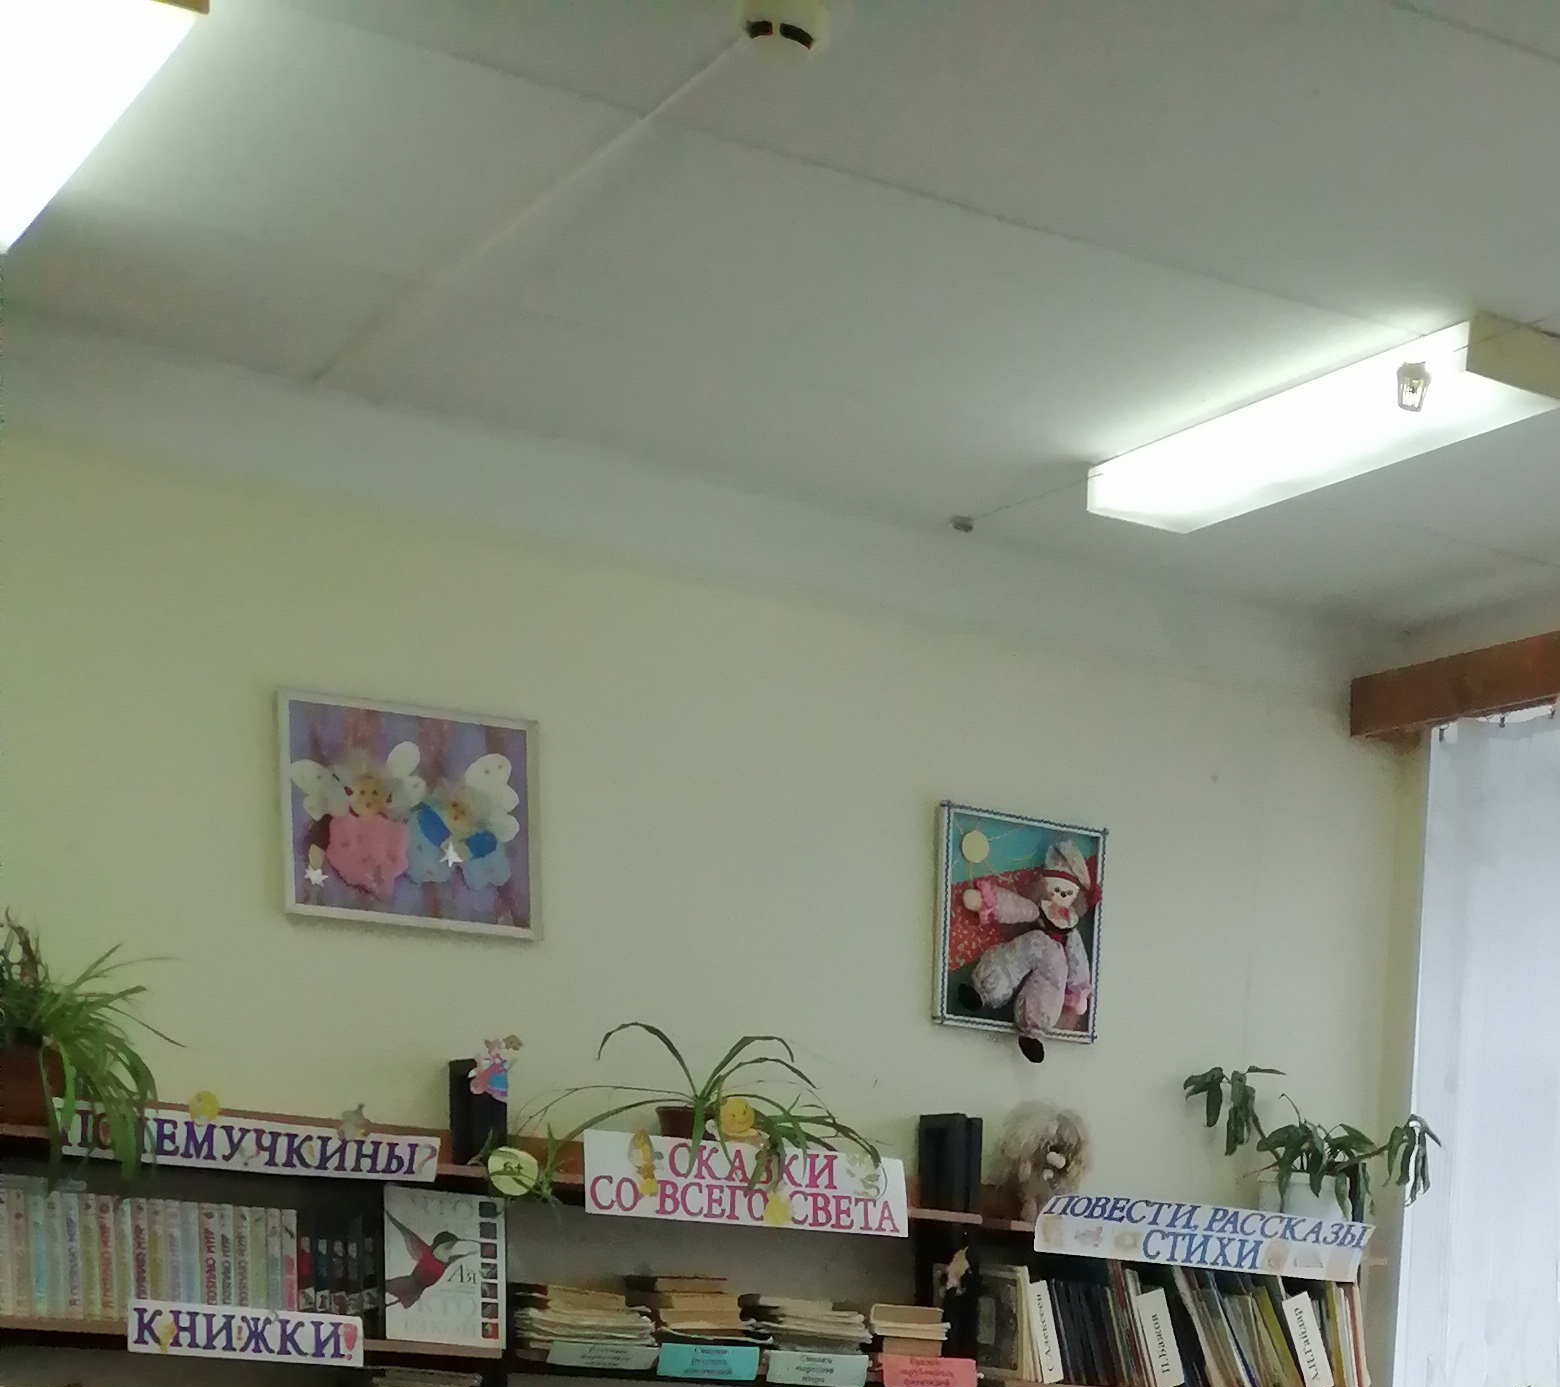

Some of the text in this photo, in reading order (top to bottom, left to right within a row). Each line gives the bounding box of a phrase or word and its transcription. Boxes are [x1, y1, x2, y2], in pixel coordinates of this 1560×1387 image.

[669, 1143, 837, 1190] СКАЗКИ
[590, 1175, 901, 1233] СО ВСЕГО СВЕТА
[1142, 1229, 1264, 1270] СТИХИ
[1204, 1208, 1371, 1250] РАССКАЗЫ
